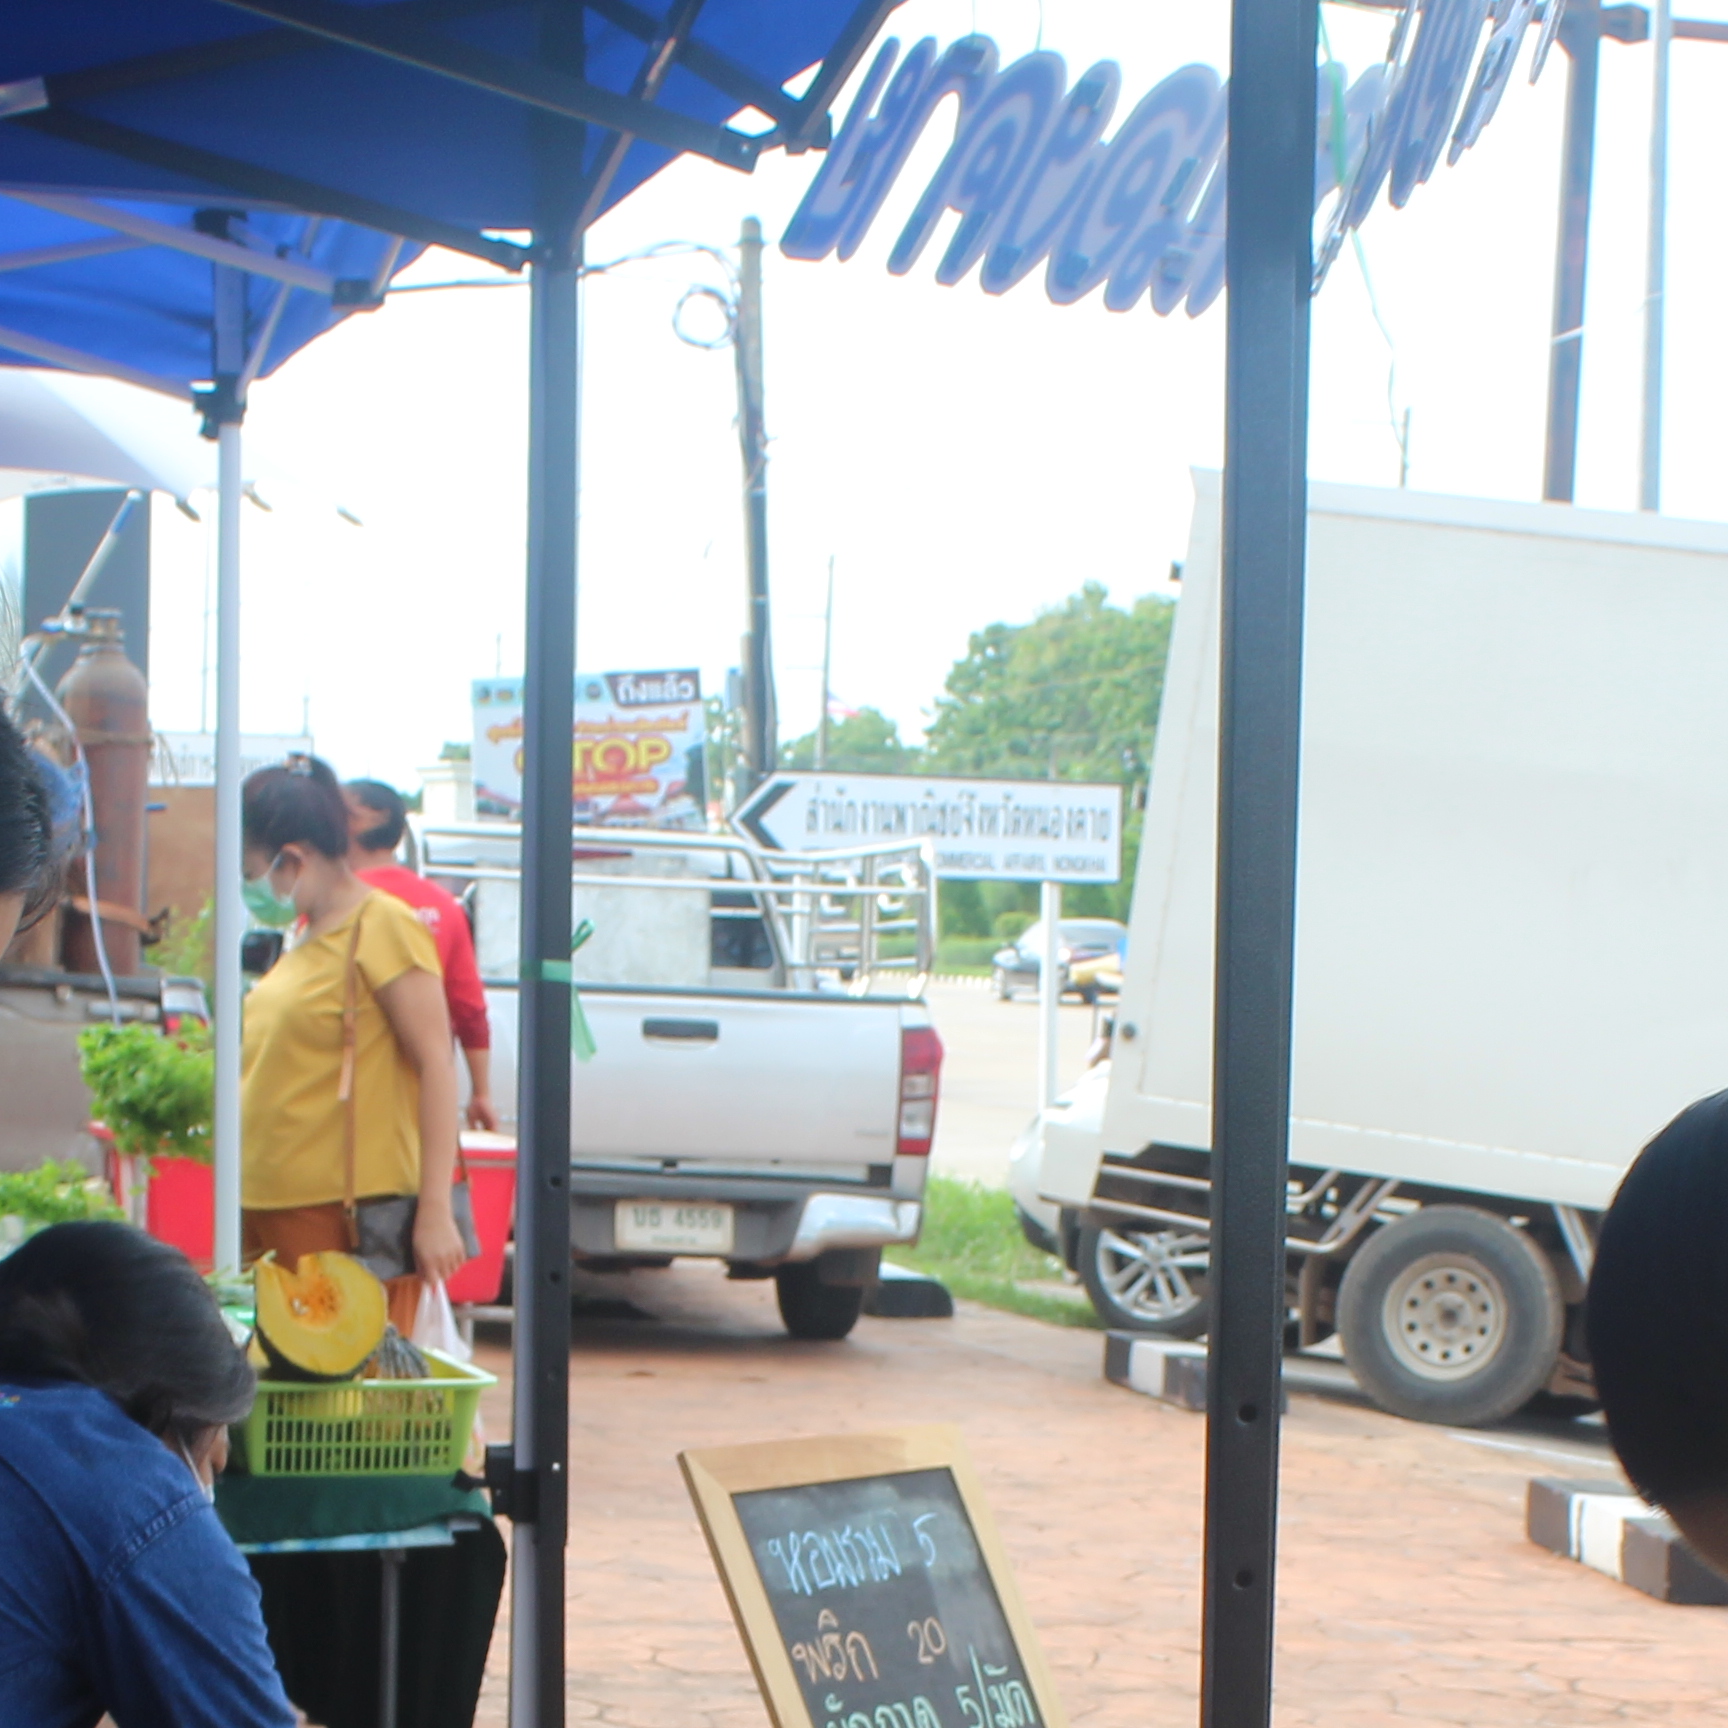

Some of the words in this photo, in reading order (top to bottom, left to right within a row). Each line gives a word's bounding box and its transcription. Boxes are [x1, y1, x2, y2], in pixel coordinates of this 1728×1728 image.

[514, 735, 672, 775] TOP
[912, 1511, 939, 1568] 5
[791, 1608, 879, 1685] พริก
[906, 1616, 947, 1665] 20
